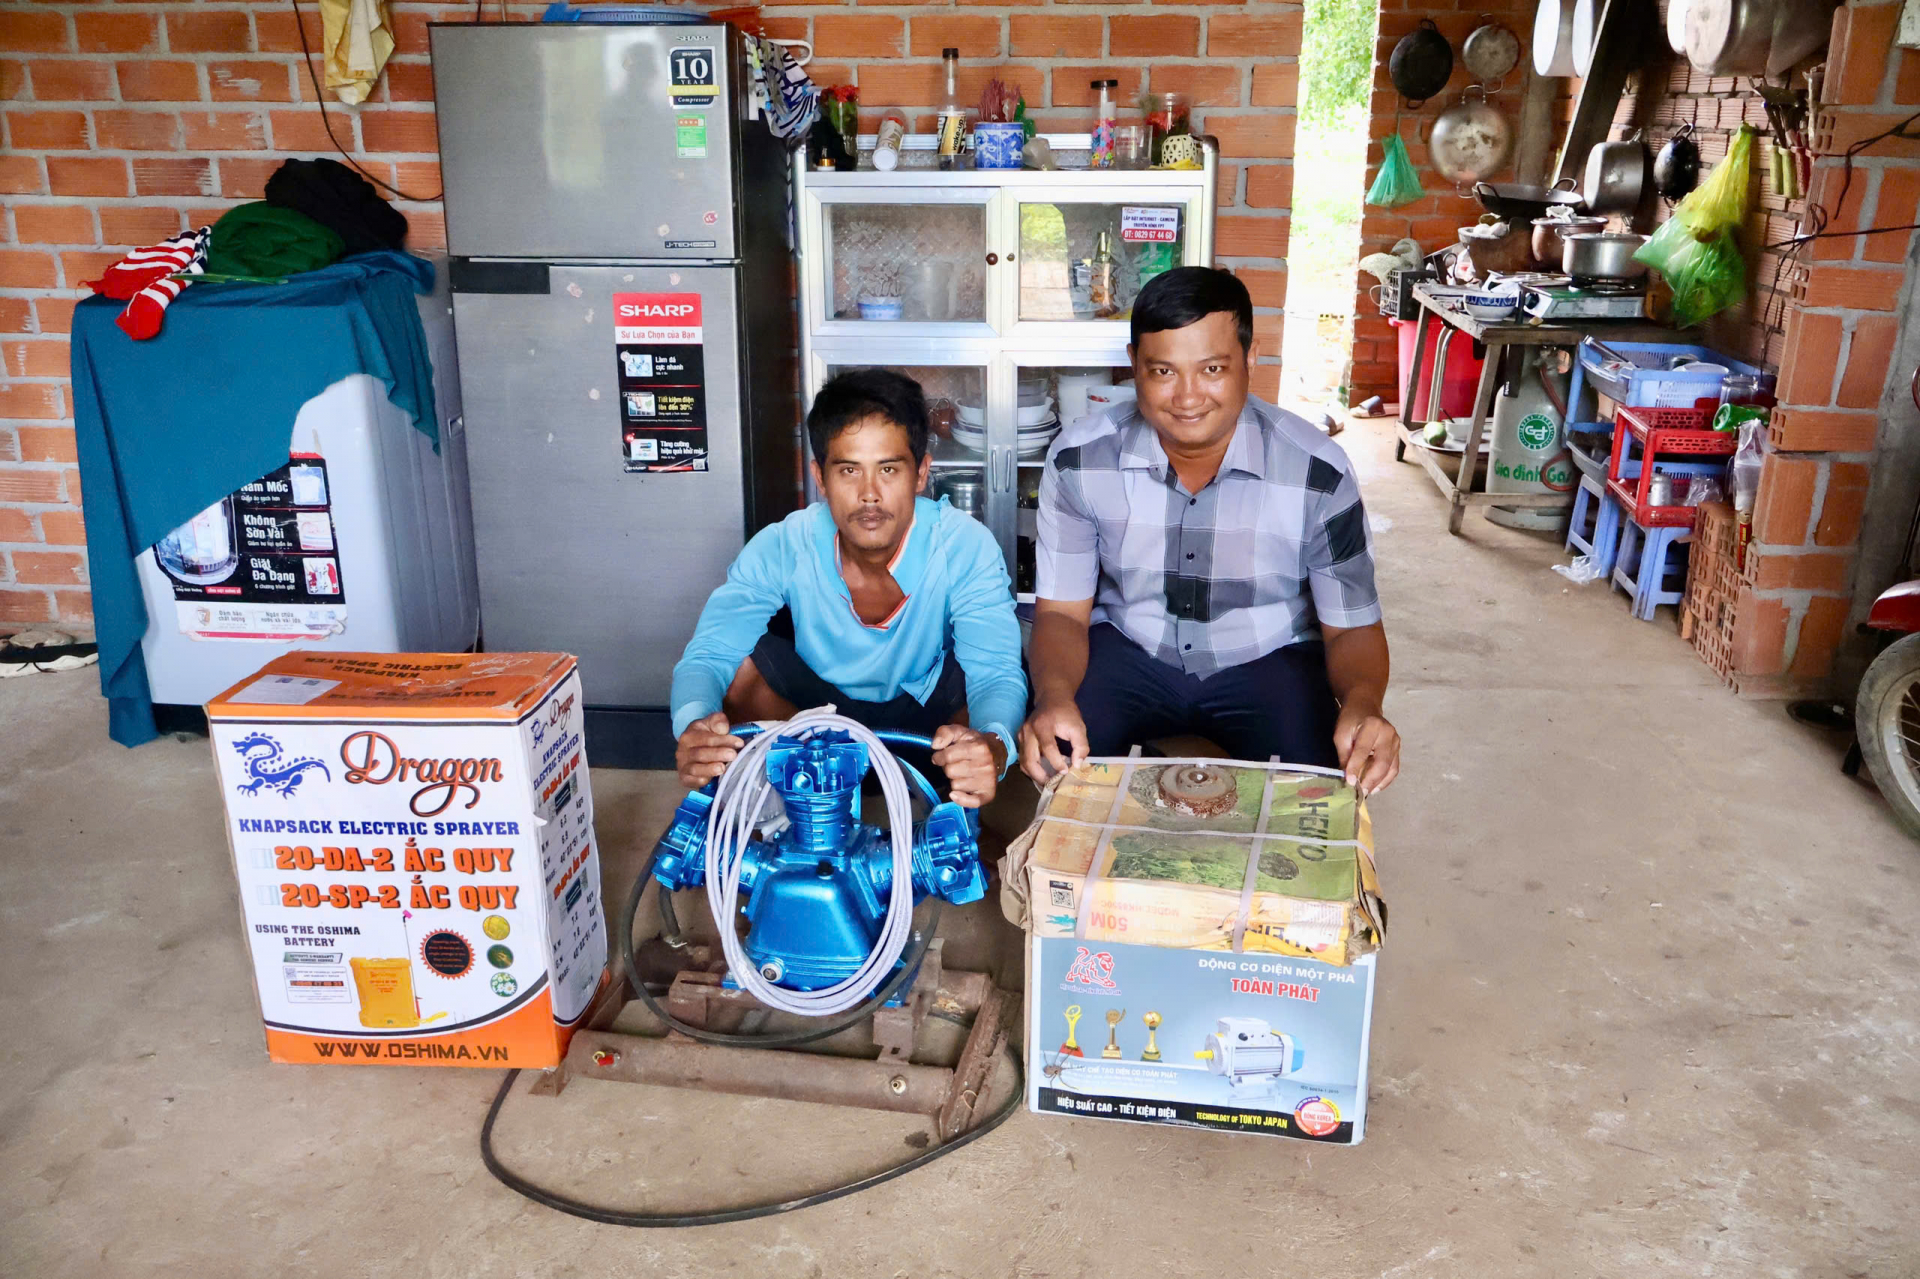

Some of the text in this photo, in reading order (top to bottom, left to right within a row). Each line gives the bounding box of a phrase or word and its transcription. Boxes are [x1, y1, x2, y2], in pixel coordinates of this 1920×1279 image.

[675, 58, 708, 79] 10
[953, 119, 963, 150] wake-up
[1149, 231, 1156, 239] 67
[1158, 231, 1164, 239] 44
[620, 304, 694, 317] SHARP
[266, 480, 289, 493] Mốc
[243, 514, 276, 527] Không
[246, 527, 284, 539] Sờn Vải
[550, 692, 574, 730] Dragon
[543, 730, 568, 764] KNAPSACK
[533, 733, 579, 791] ELECTRIC SPRAYER
[340, 731, 503, 817] Dragon
[239, 818, 519, 835] KNAPSACK ELECTRIC SPRAYER
[274, 837, 514, 874] 20-DA-2 ẮC QUY
[280, 875, 519, 911] 20-SP-2 ẮC QUY
[255, 924, 361, 935] USING THE OSHIMA
[1091, 912, 1128, 931] 50M
[284, 937, 335, 947] BATTERY
[1198, 958, 1355, 984] ĐỘNG CƠ ĐIỆN MỘT PHA
[1231, 977, 1320, 1002] TOÀN PHÁT
[313, 1042, 509, 1061] WWW.OSHIMA.VN
[1057, 1096, 1075, 1109] HIỆU
[1076, 1098, 1094, 1111] SUẤT
[1096, 1102, 1112, 1112] CAO
[1119, 1101, 1135, 1115] TIẾT
[1137, 1104, 1156, 1118] KIỆM
[1158, 1106, 1177, 1120] ĐIỆN
[1196, 1112, 1230, 1122] TECHNOLOGY
[1239, 1114, 1262, 1125] TOKYO
[1263, 1116, 1288, 1129] JAPAN
